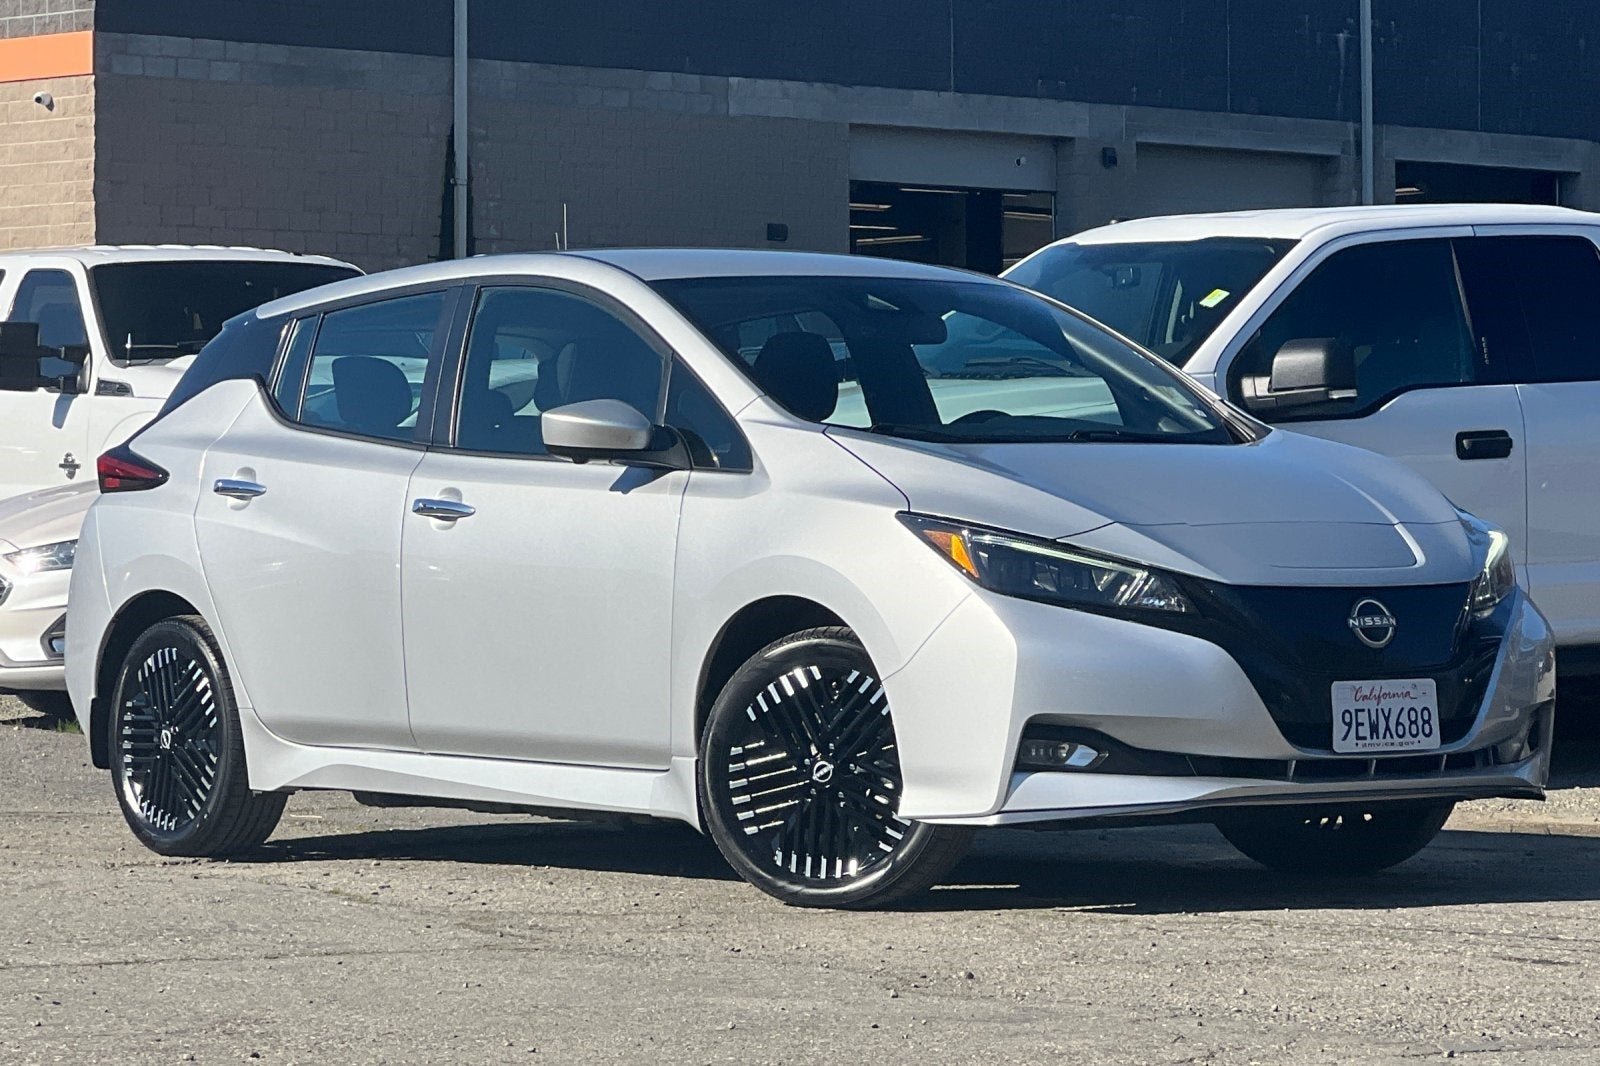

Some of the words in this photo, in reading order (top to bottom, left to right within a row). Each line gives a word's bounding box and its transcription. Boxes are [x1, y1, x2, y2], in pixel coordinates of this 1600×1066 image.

[1349, 616, 1396, 627] NISSAN
[1354, 685, 1414, 706] California
[1341, 706, 1433, 741] 9EWX688
